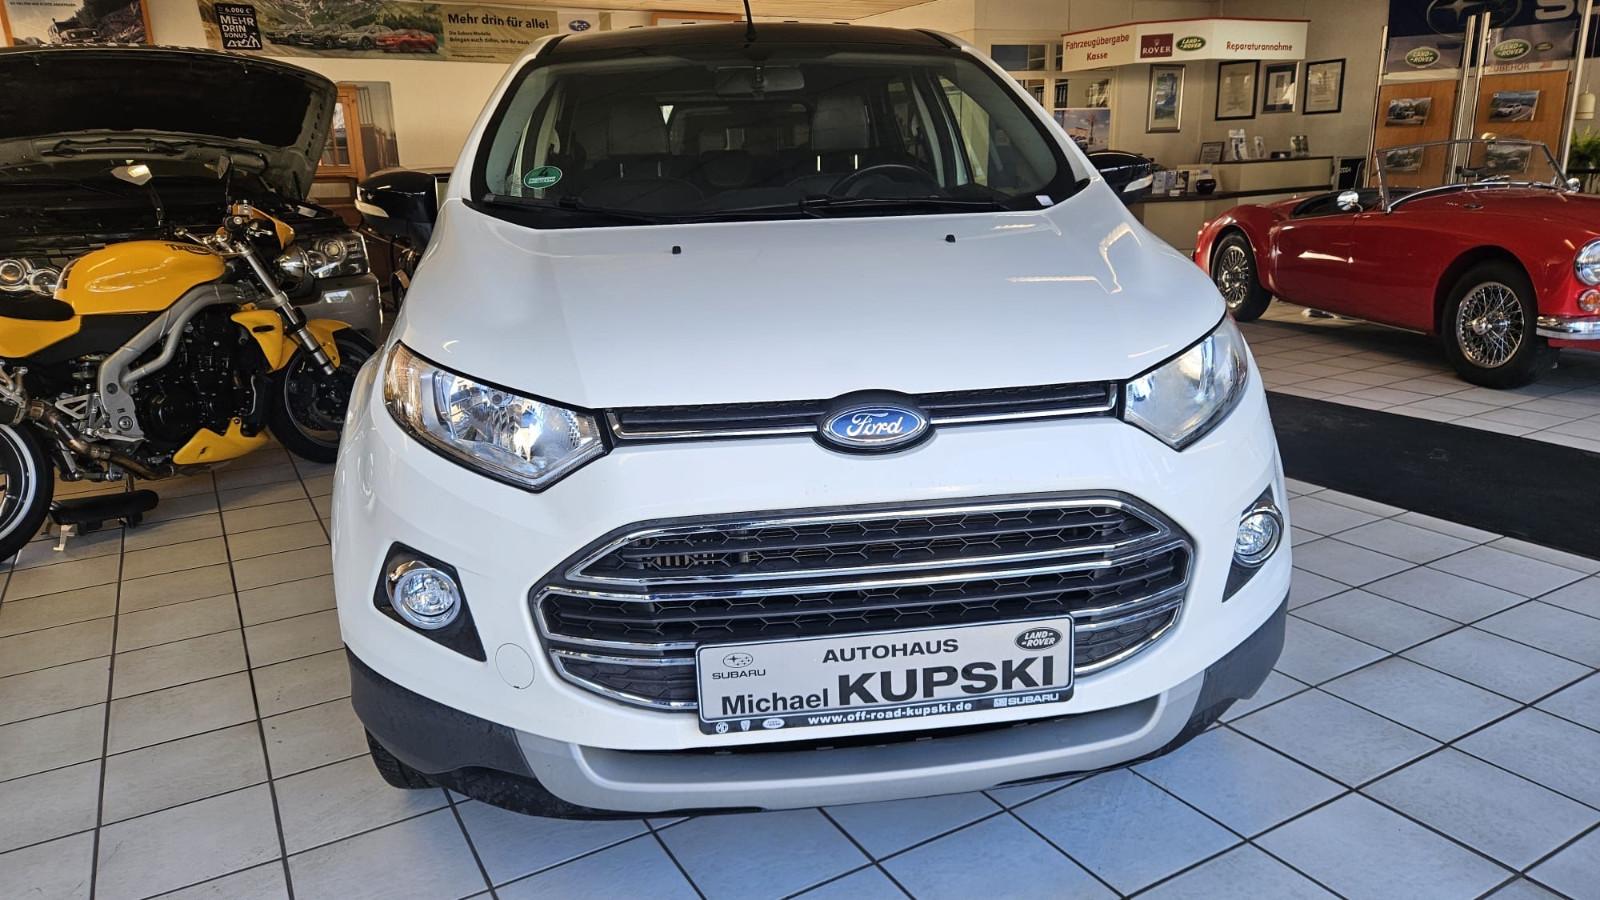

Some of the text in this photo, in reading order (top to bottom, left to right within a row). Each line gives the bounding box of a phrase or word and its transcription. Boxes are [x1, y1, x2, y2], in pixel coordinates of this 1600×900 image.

[219, 15, 255, 26] MEHR
[448, 13, 550, 29] Mehr drin für alle!
[222, 24, 247, 33] DRIN
[1065, 33, 1130, 50] Fahrzeugübergabe
[1226, 41, 1293, 52] Reparaturannahme
[1086, 51, 1108, 61] Kasse
[1142, 45, 1171, 54] ROVER
[847, 413, 904, 436] Ford
[822, 638, 959, 663] AUTOHAUS
[712, 668, 766, 680] SUBARU
[721, 655, 1054, 715] Michael KUPSKI
[1008, 692, 1060, 706] SUBARU
[807, 702, 972, 725] www.off-road-kupski.de
